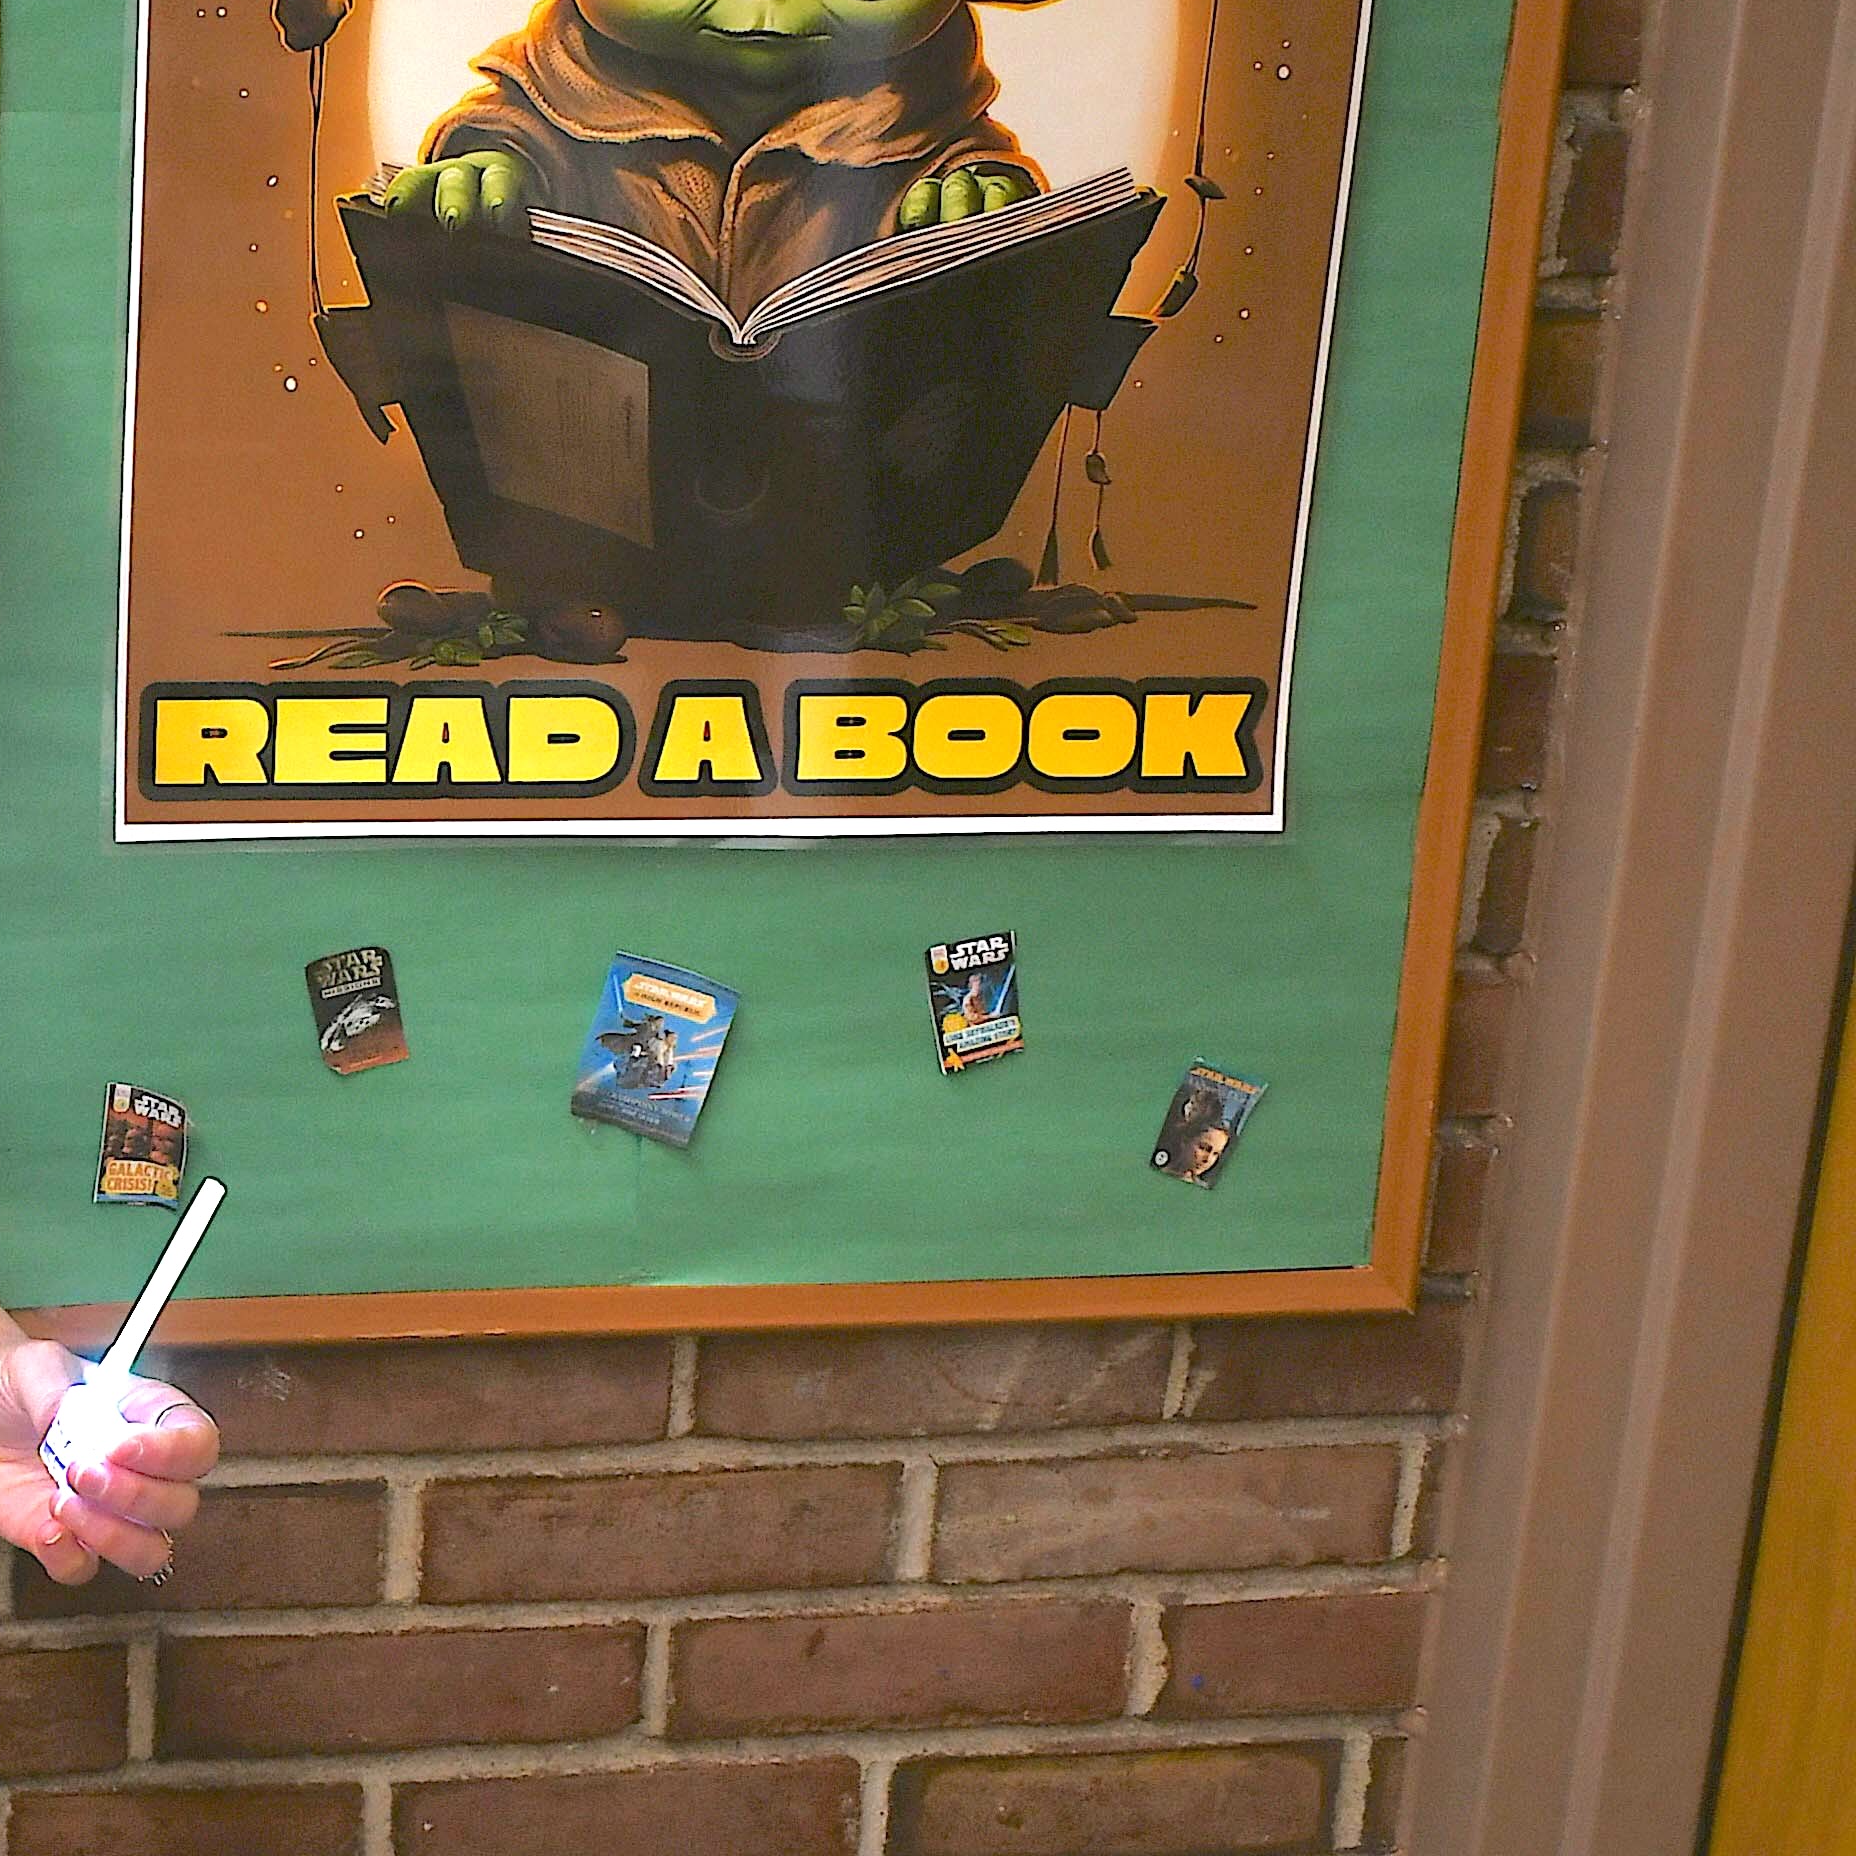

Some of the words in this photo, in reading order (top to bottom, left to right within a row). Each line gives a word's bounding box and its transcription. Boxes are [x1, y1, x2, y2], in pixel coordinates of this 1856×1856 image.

[155, 699, 619, 784] READ
[657, 697, 763, 781] A
[799, 694, 1253, 778] BOOK
[950, 937, 1008, 959] STAR
[951, 948, 1010, 970] WARS
